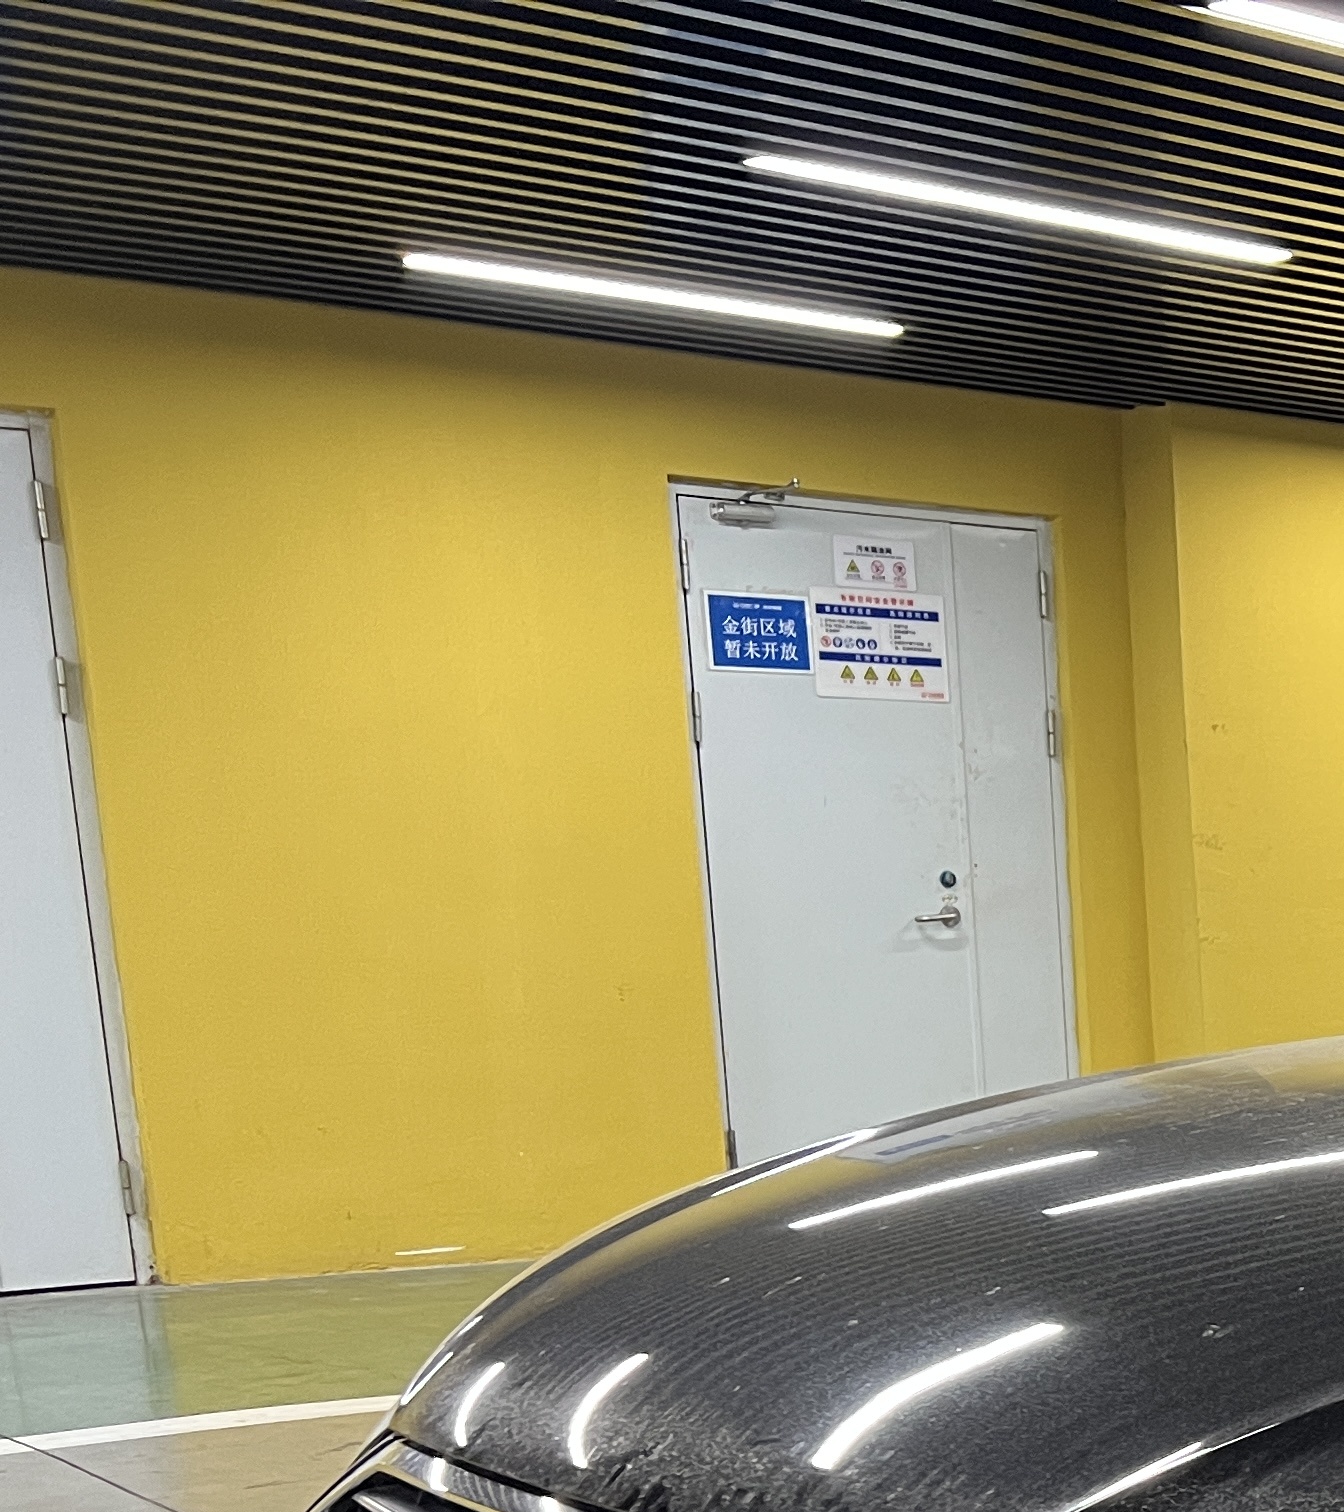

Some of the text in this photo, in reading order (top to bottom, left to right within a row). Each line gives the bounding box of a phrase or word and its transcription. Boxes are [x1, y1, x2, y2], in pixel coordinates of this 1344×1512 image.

[722, 615, 797, 638] 金街区域
[724, 639, 799, 661] 暂未开放
